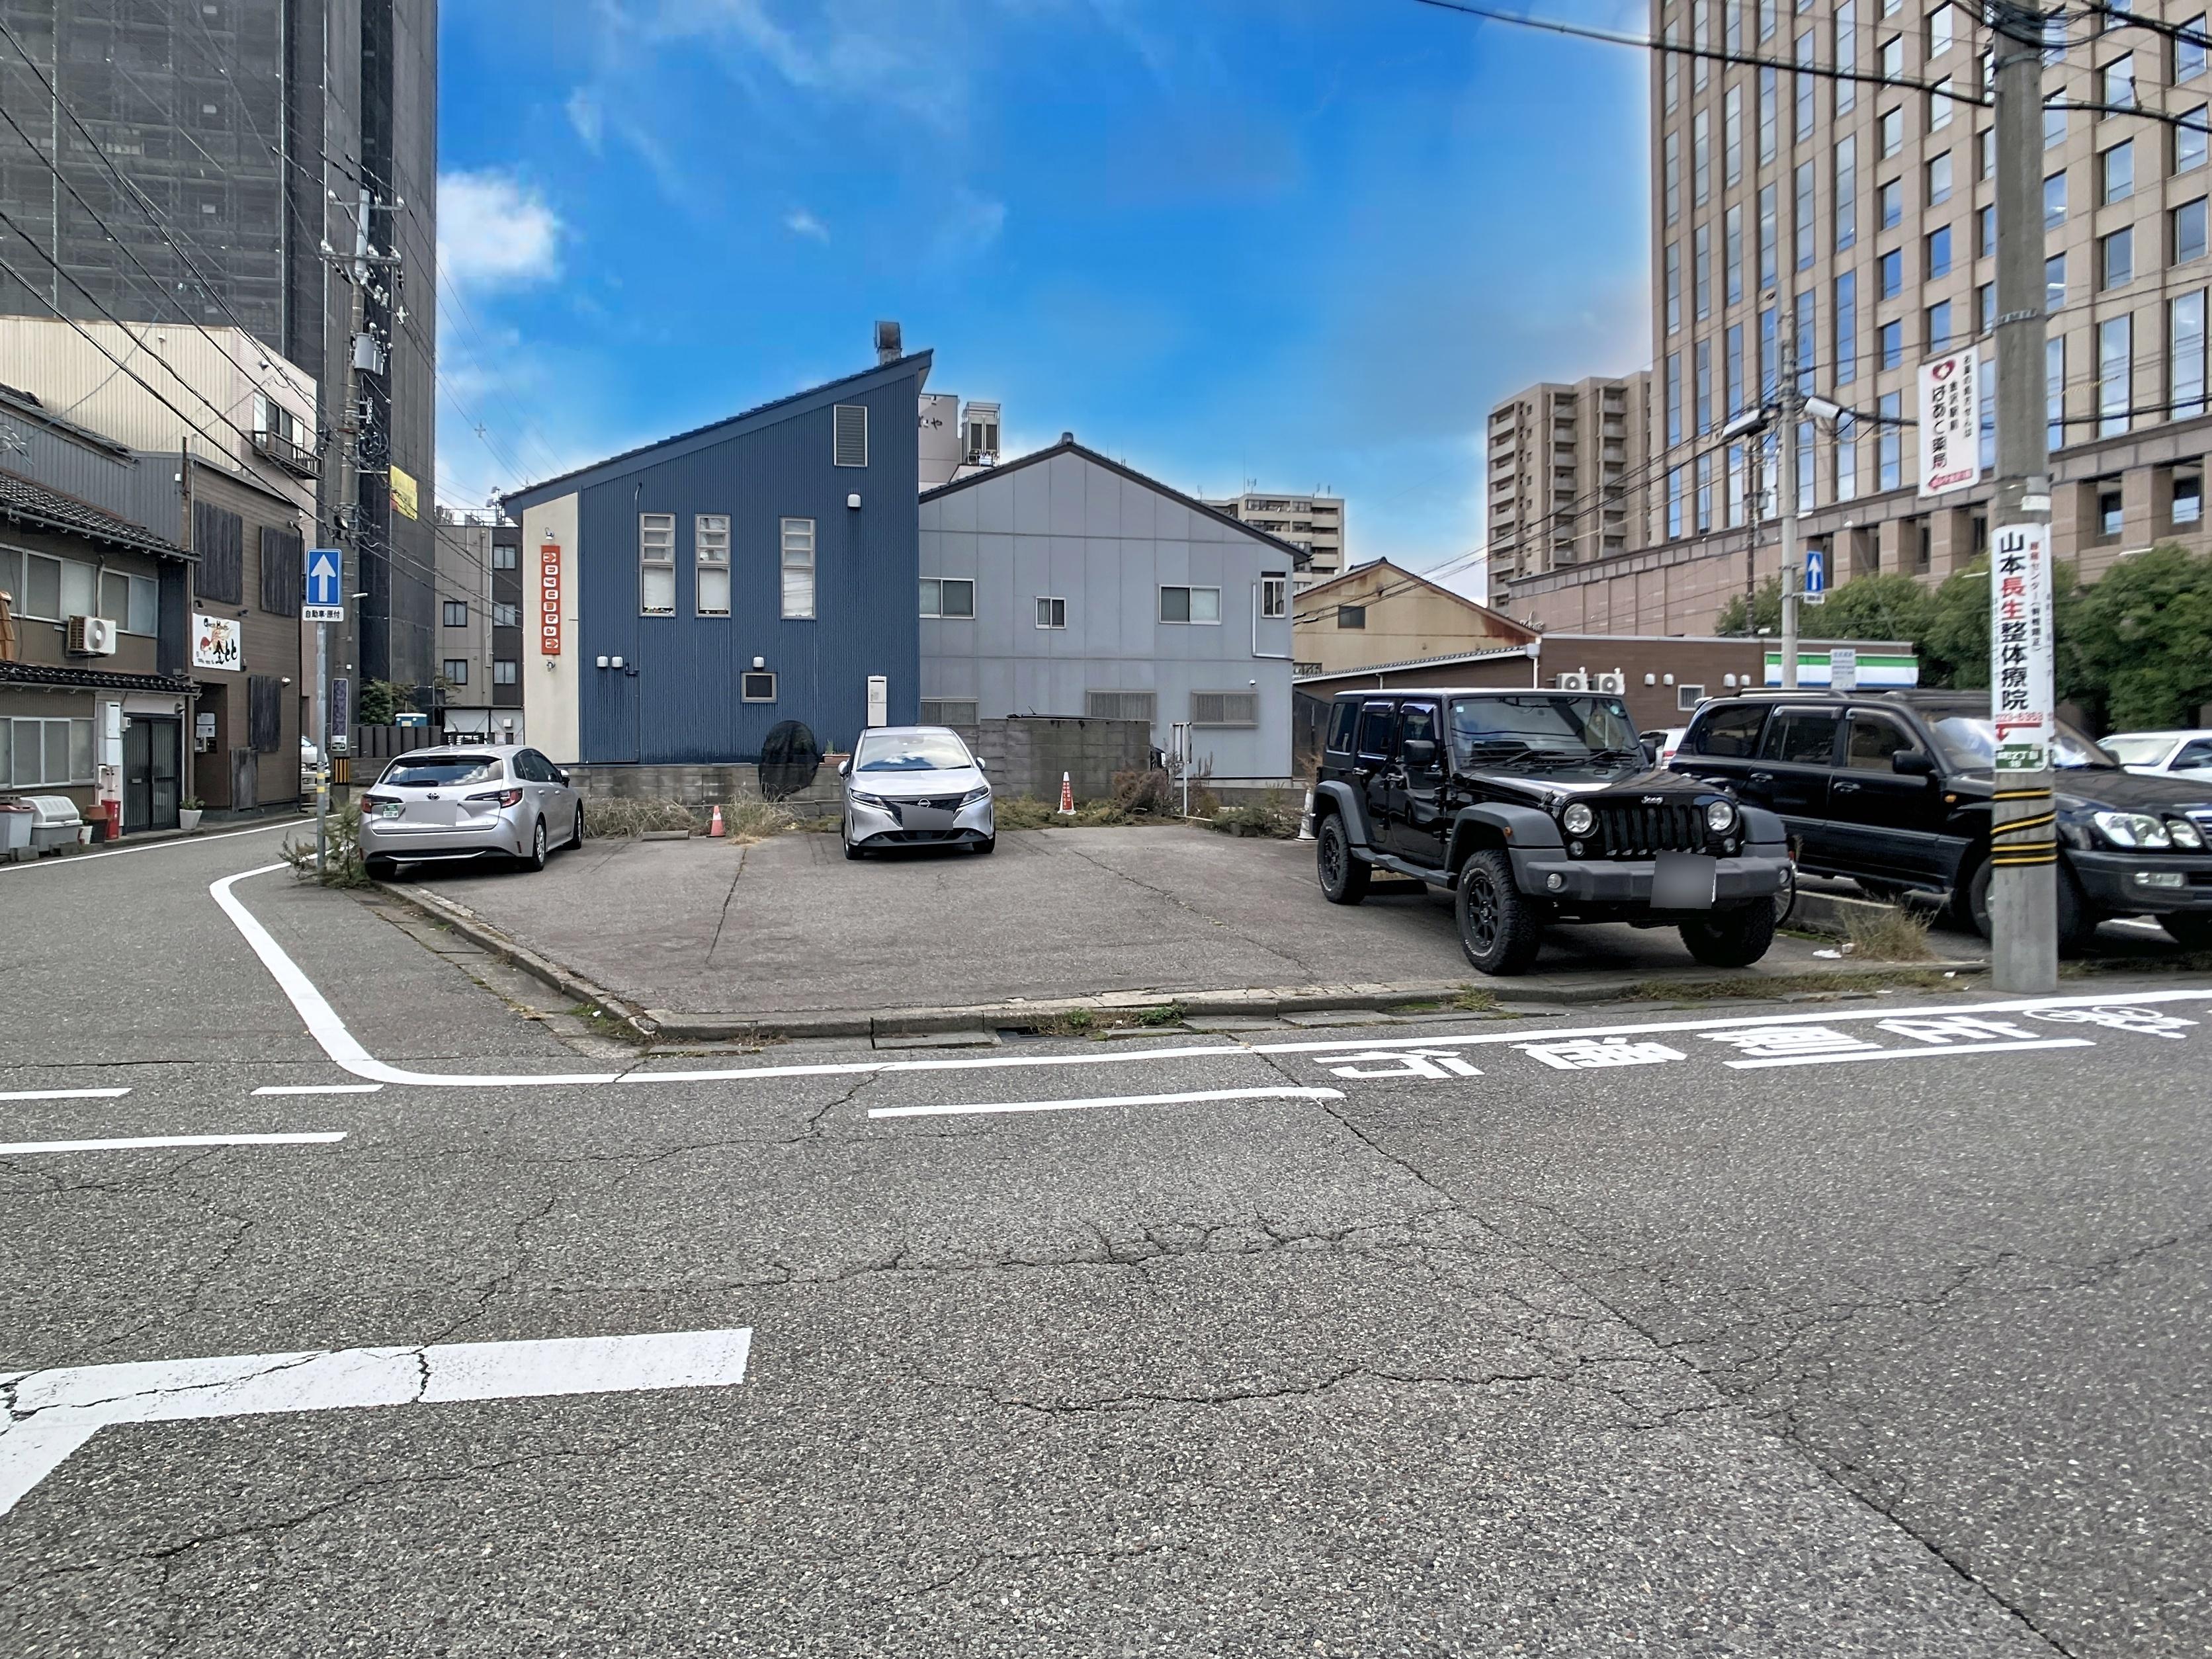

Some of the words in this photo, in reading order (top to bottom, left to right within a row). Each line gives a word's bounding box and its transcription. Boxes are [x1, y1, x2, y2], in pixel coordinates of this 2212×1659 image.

[1999, 531, 2029, 710] 山本長生整体療院
